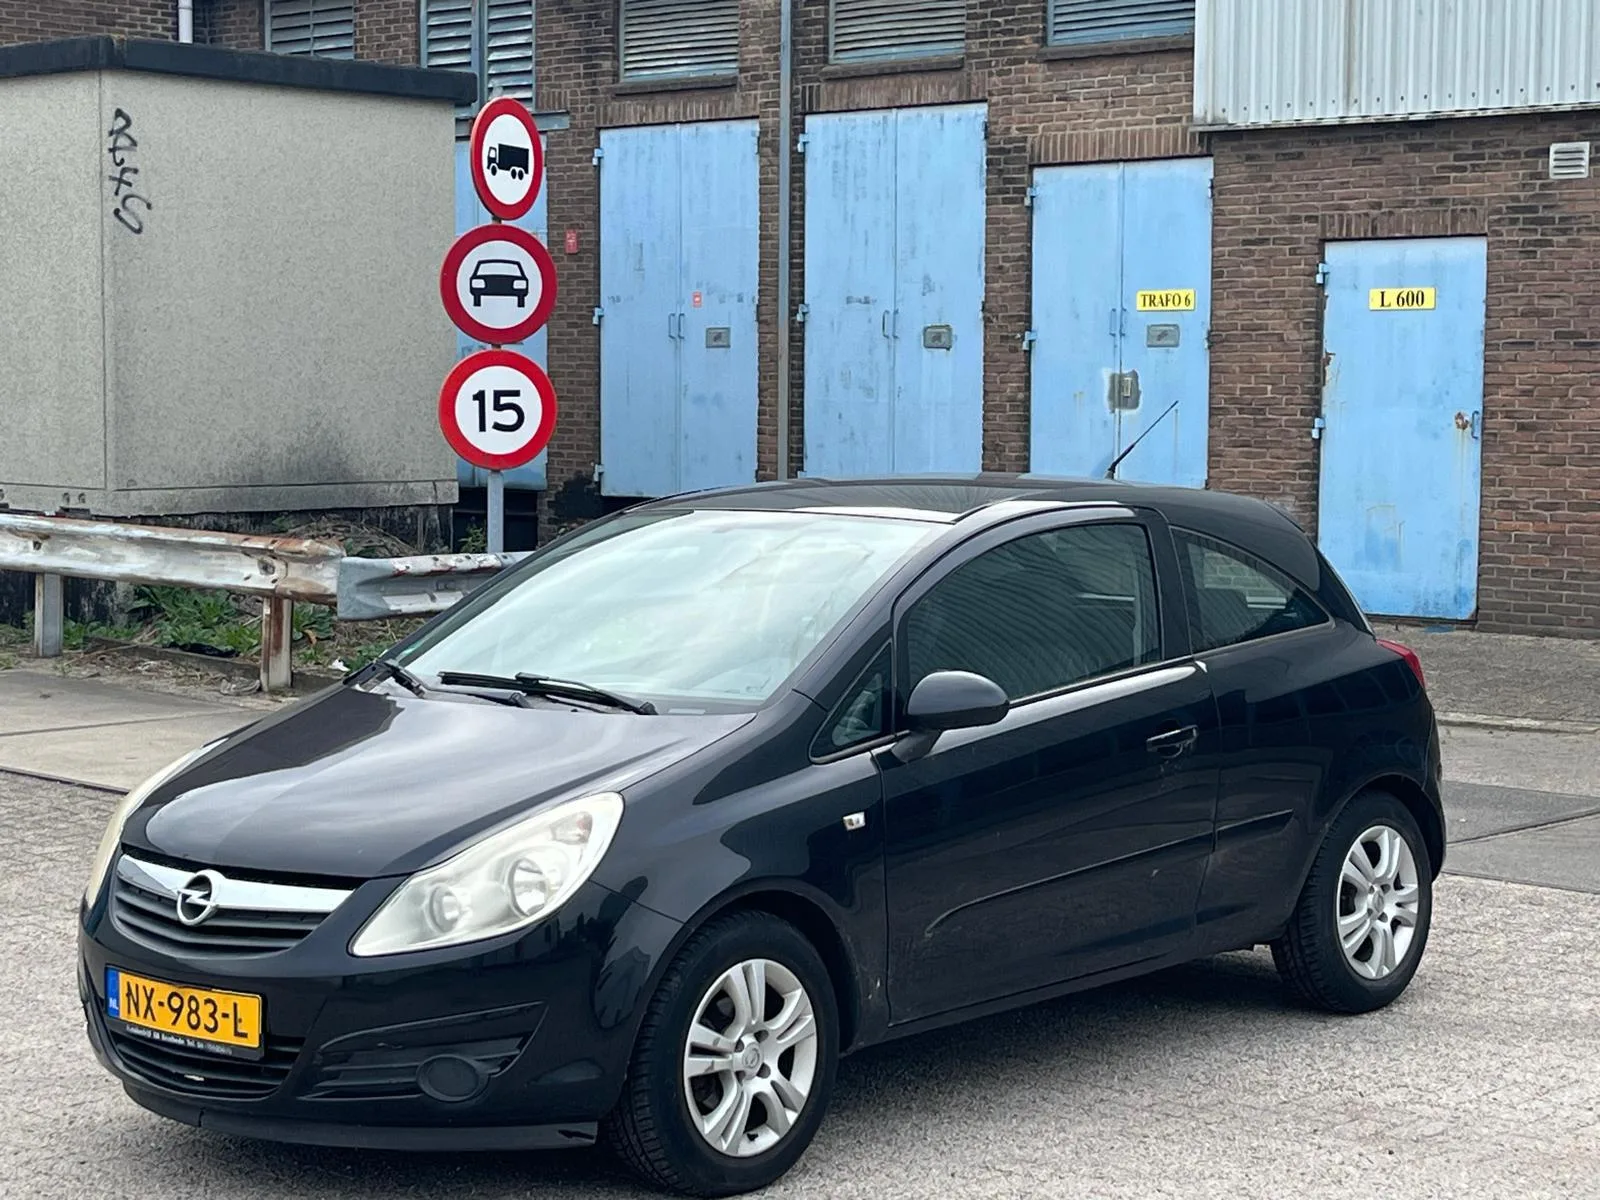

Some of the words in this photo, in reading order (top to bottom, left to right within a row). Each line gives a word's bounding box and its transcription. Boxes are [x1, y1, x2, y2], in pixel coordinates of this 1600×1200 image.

[1140, 293, 1181, 308] TRAFO
[1184, 292, 1191, 307] 6
[1380, 290, 1392, 308] L
[1396, 289, 1425, 307] 600
[472, 389, 525, 433] 15
[125, 981, 249, 1039] NX-983-L
